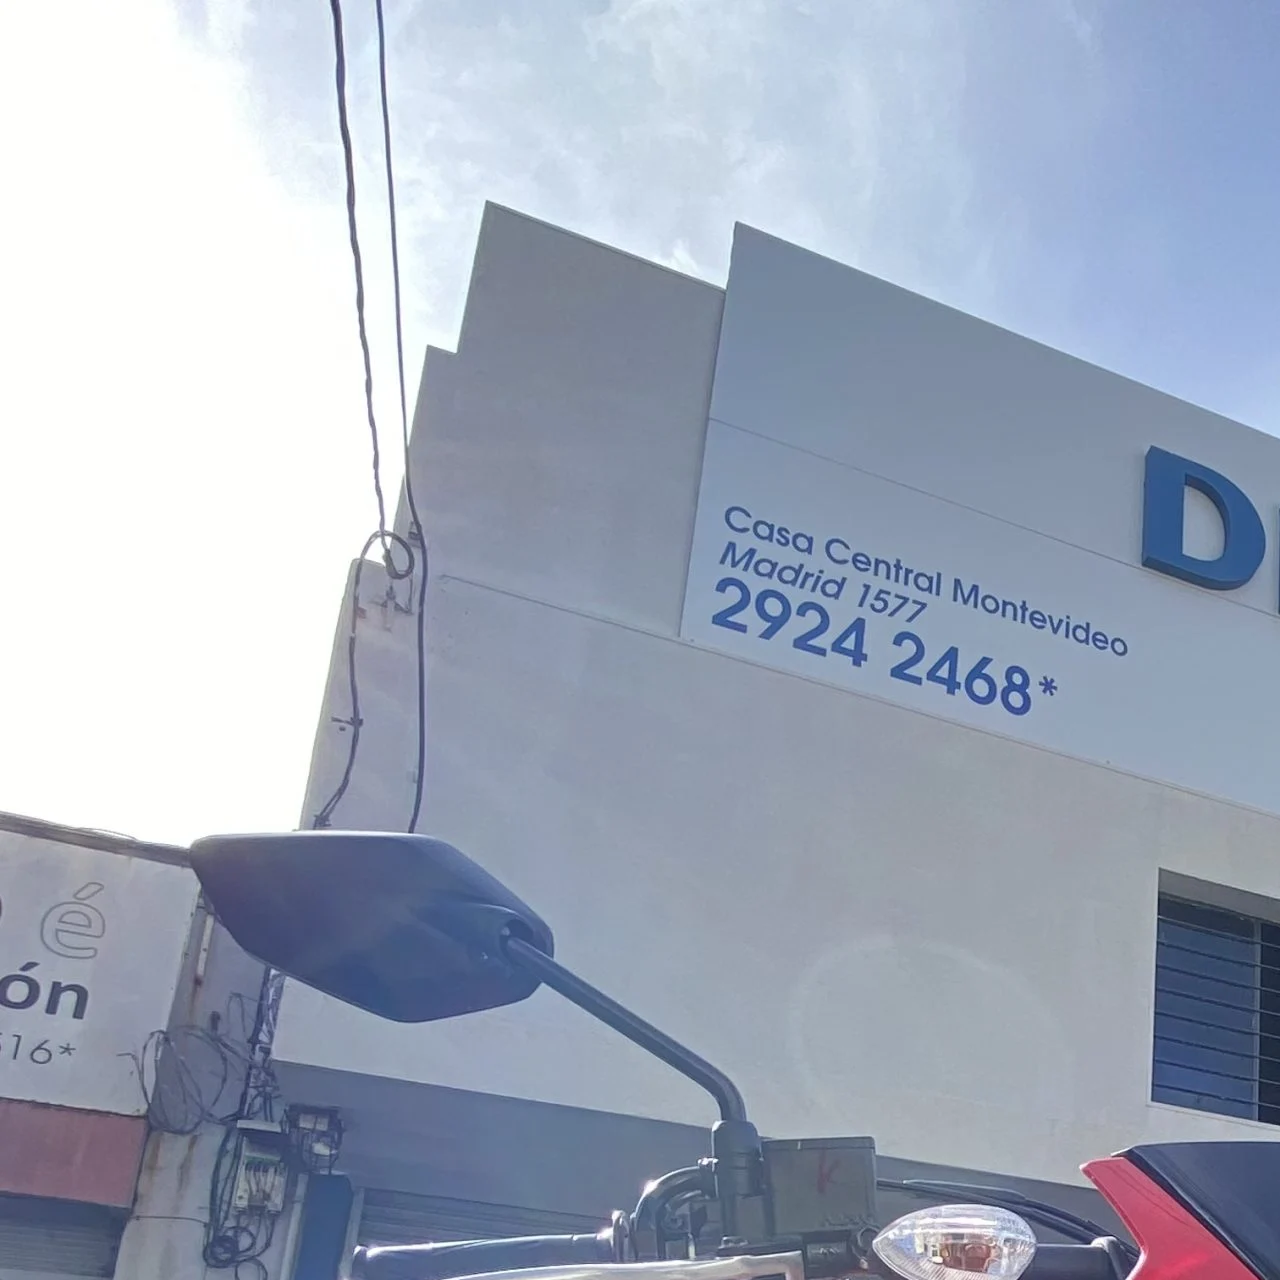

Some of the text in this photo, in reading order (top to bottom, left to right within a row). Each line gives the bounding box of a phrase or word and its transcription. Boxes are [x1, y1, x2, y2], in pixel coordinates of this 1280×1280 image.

[712, 577, 869, 668] 2924
[719, 541, 928, 624] Madrid 1577
[724, 506, 1129, 657] Casa Central Montevideo
